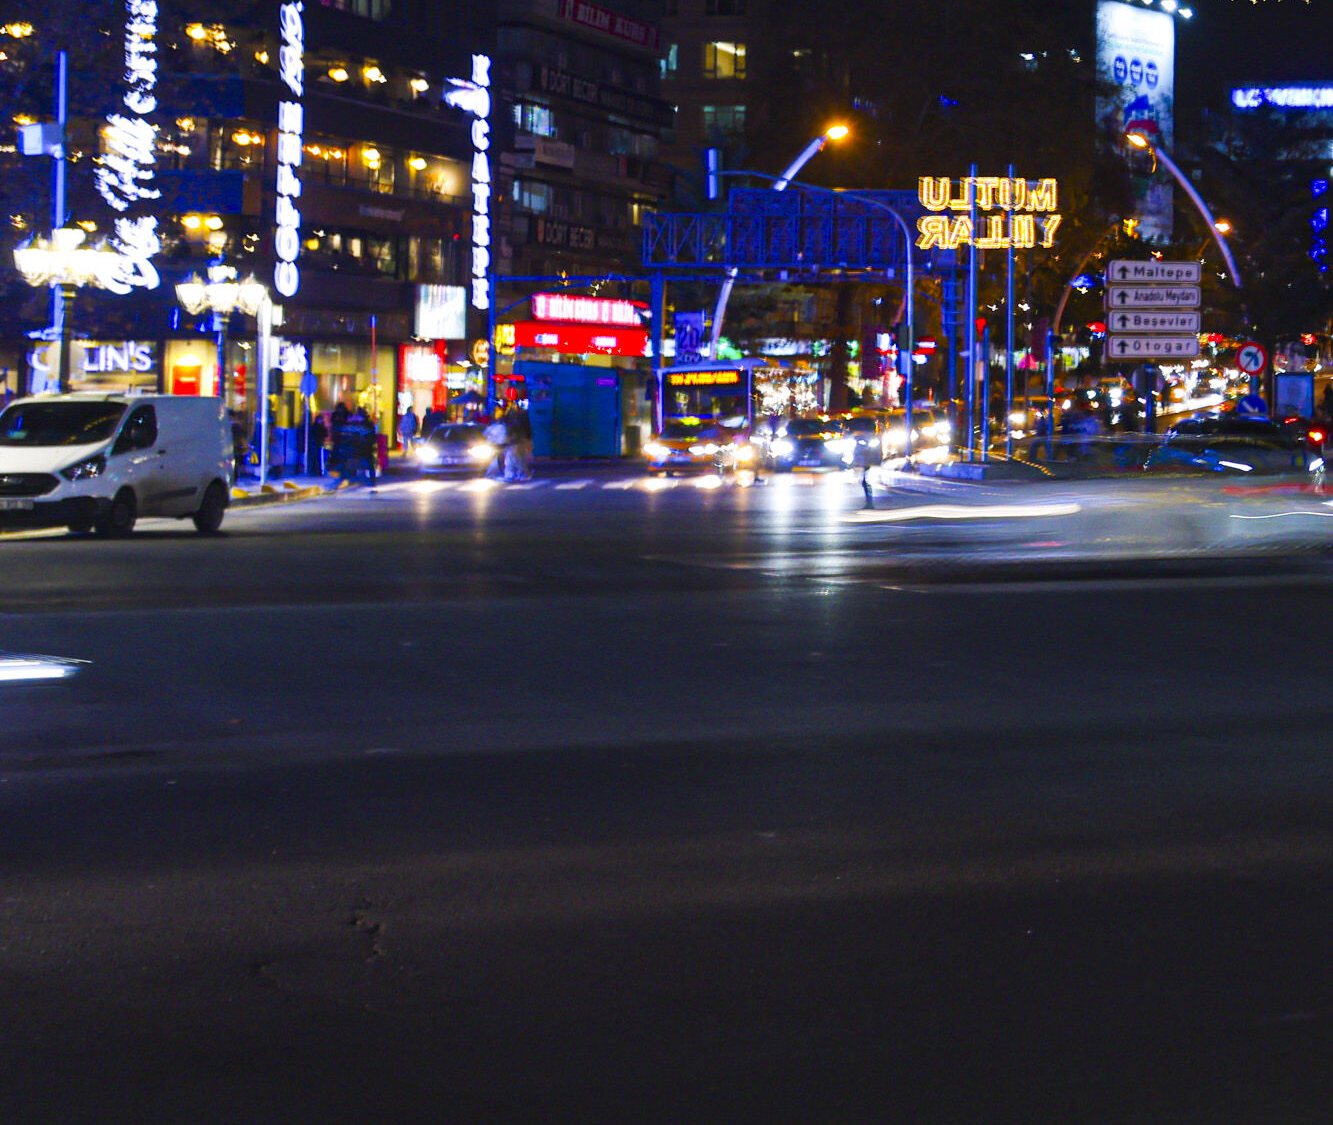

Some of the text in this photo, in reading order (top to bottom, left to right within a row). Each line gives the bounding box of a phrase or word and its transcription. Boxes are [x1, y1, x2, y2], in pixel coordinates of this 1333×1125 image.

[1134, 266, 1193, 280] Maltepe
[1133, 315, 1193, 328] Beşevler
[1133, 340, 1191, 353] Otogar
[28, 340, 155, 373] CLIN'S
